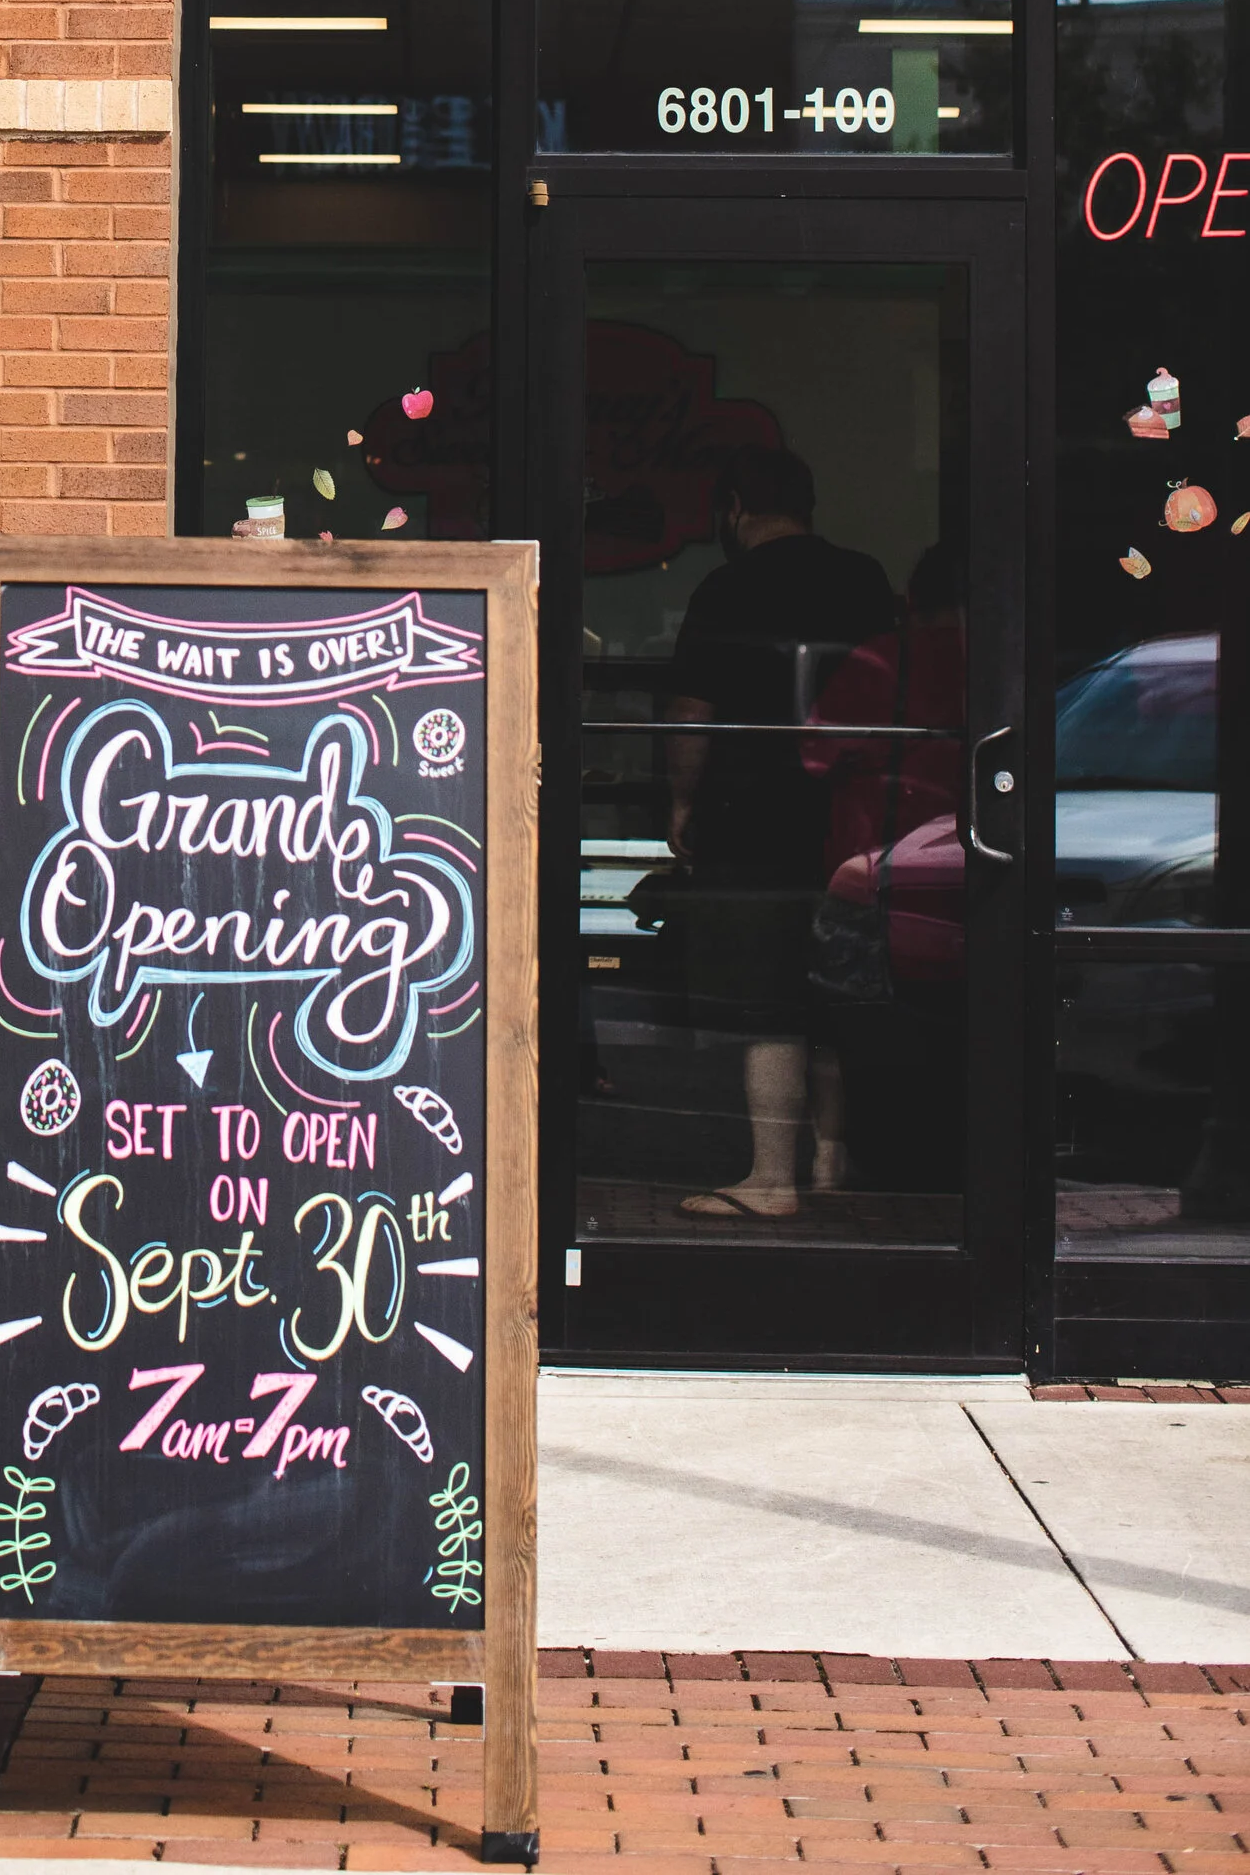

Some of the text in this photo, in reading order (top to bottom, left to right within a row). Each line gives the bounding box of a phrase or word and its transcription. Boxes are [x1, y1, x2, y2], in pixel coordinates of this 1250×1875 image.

[658, 87, 895, 133] 6801-100
[84, 616, 405, 679] THE WAIT IS OVER!
[418, 757, 464, 778] Sweet
[81, 730, 410, 908] Grand
[41, 840, 451, 1044] Opening
[105, 1099, 378, 1171] SET TO OPEN
[209, 1174, 269, 1226] ON
[62, 1174, 277, 1352] Sept.
